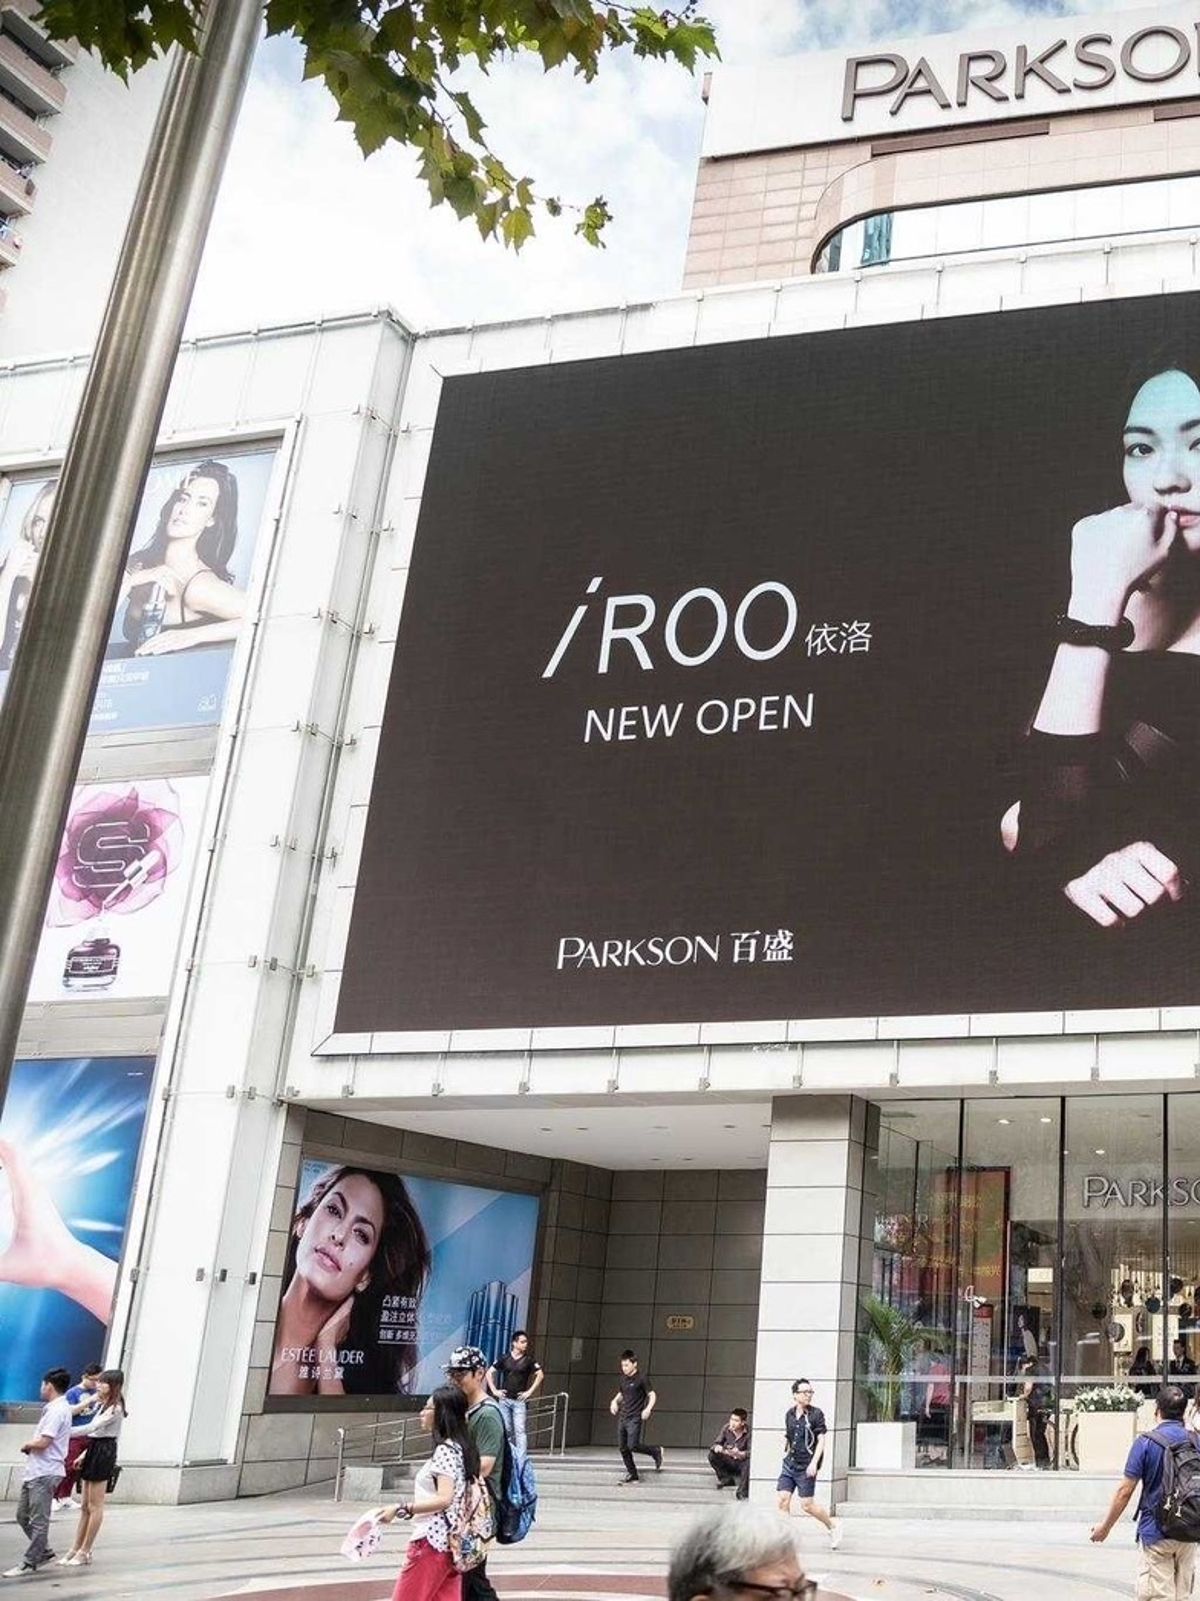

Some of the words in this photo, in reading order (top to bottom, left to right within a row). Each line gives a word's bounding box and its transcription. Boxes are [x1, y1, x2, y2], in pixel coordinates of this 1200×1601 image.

[541, 576, 798, 678] iROO
[804, 620, 873, 657] 依洛
[584, 703, 684, 743] NEW
[696, 693, 814, 735] OPEN
[557, 935, 720, 969] PARKSON
[730, 928, 794, 963] 百盛
[319, 1348, 365, 1365] LAUDER
